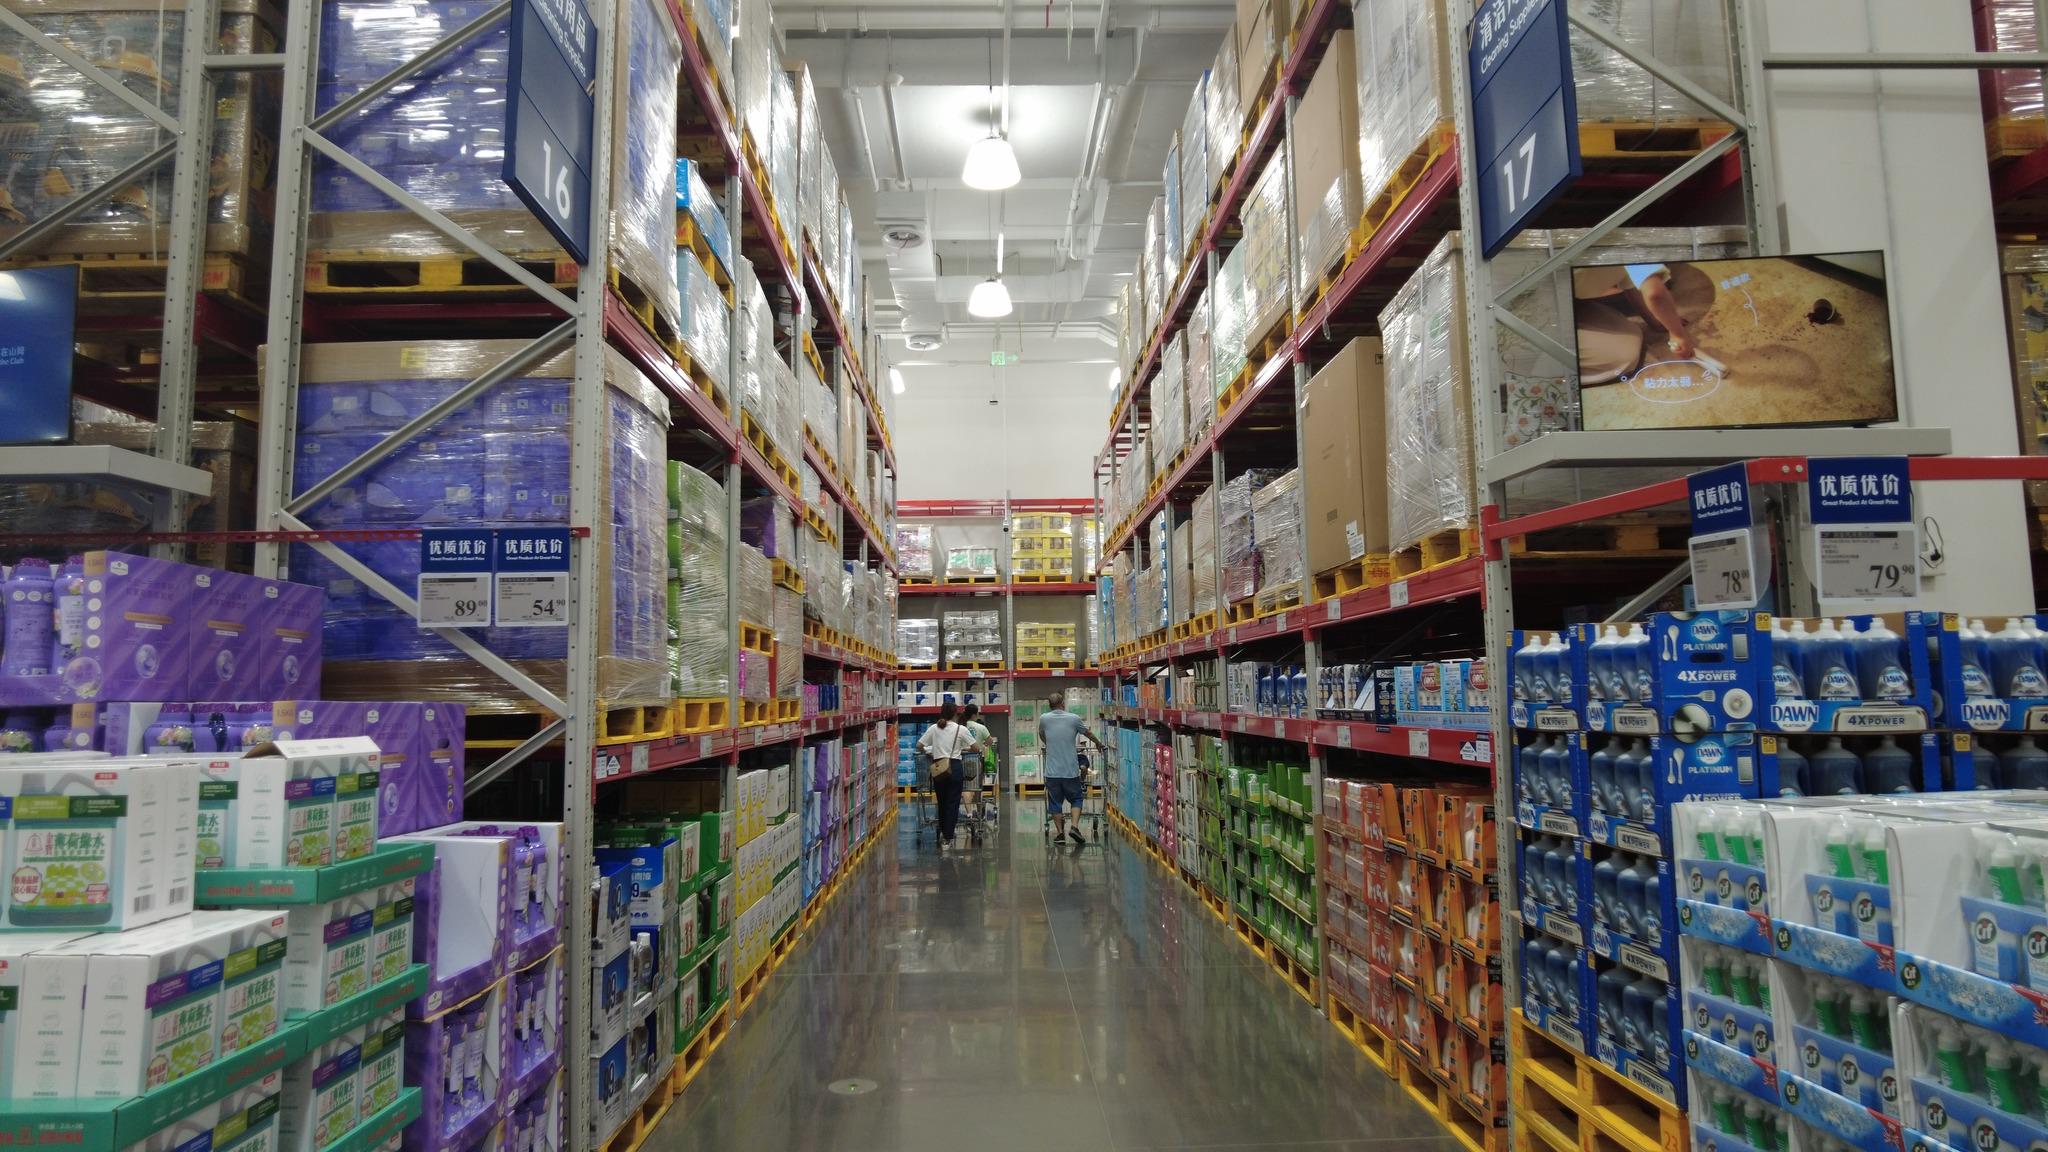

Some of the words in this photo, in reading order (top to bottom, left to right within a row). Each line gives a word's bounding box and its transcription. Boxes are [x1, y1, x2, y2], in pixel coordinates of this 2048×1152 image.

[1481, 32, 1509, 75] Cleaning
[543, 139, 571, 220] 16
[1504, 132, 1537, 214] 17
[1818, 474, 1900, 497] 优质优价
[1694, 480, 1743, 511] 优质优价
[429, 540, 487, 555] 优质优价
[505, 539, 563, 554] 优质优价
[1692, 624, 1719, 635] DAWN
[1683, 642, 1729, 651] PLATINUM
[1678, 670, 1698, 682] 4X
[1698, 673, 1738, 681] POWER
[1827, 674, 1849, 684] DAWN
[1882, 674, 1905, 684] DAWN
[1772, 706, 1817, 722] DAWN
[1848, 715, 1866, 725] 4X
[1868, 717, 1905, 725] POWER
[1963, 704, 2009, 721] DAWN
[1697, 748, 1723, 757] DAWN
[1688, 766, 1733, 774] PLATINUM
[1691, 877, 1703, 889] Cif
[1720, 882, 1731, 896] Cif
[1750, 887, 1762, 902] Cif
[1817, 895, 1832, 909] Cif
[1858, 903, 1874, 918] Cif
[1778, 931, 1790, 943] Cif
[1976, 923, 1993, 941] Cif
[2029, 936, 2047, 955] Cif
[1904, 965, 1917, 979] Cif
[1698, 1013, 1709, 1026] Cif
[1725, 1023, 1737, 1038] Cif
[1755, 1035, 1768, 1050] Cif
[1805, 1051, 1820, 1065] Cif
[1843, 1066, 1858, 1082] Cif
[1787, 1086, 1798, 1097] Cif
[1882, 1081, 1897, 1098] Cif
[1928, 1110, 1944, 1127] Cif
[1977, 1130, 1996, 1148] Cif
